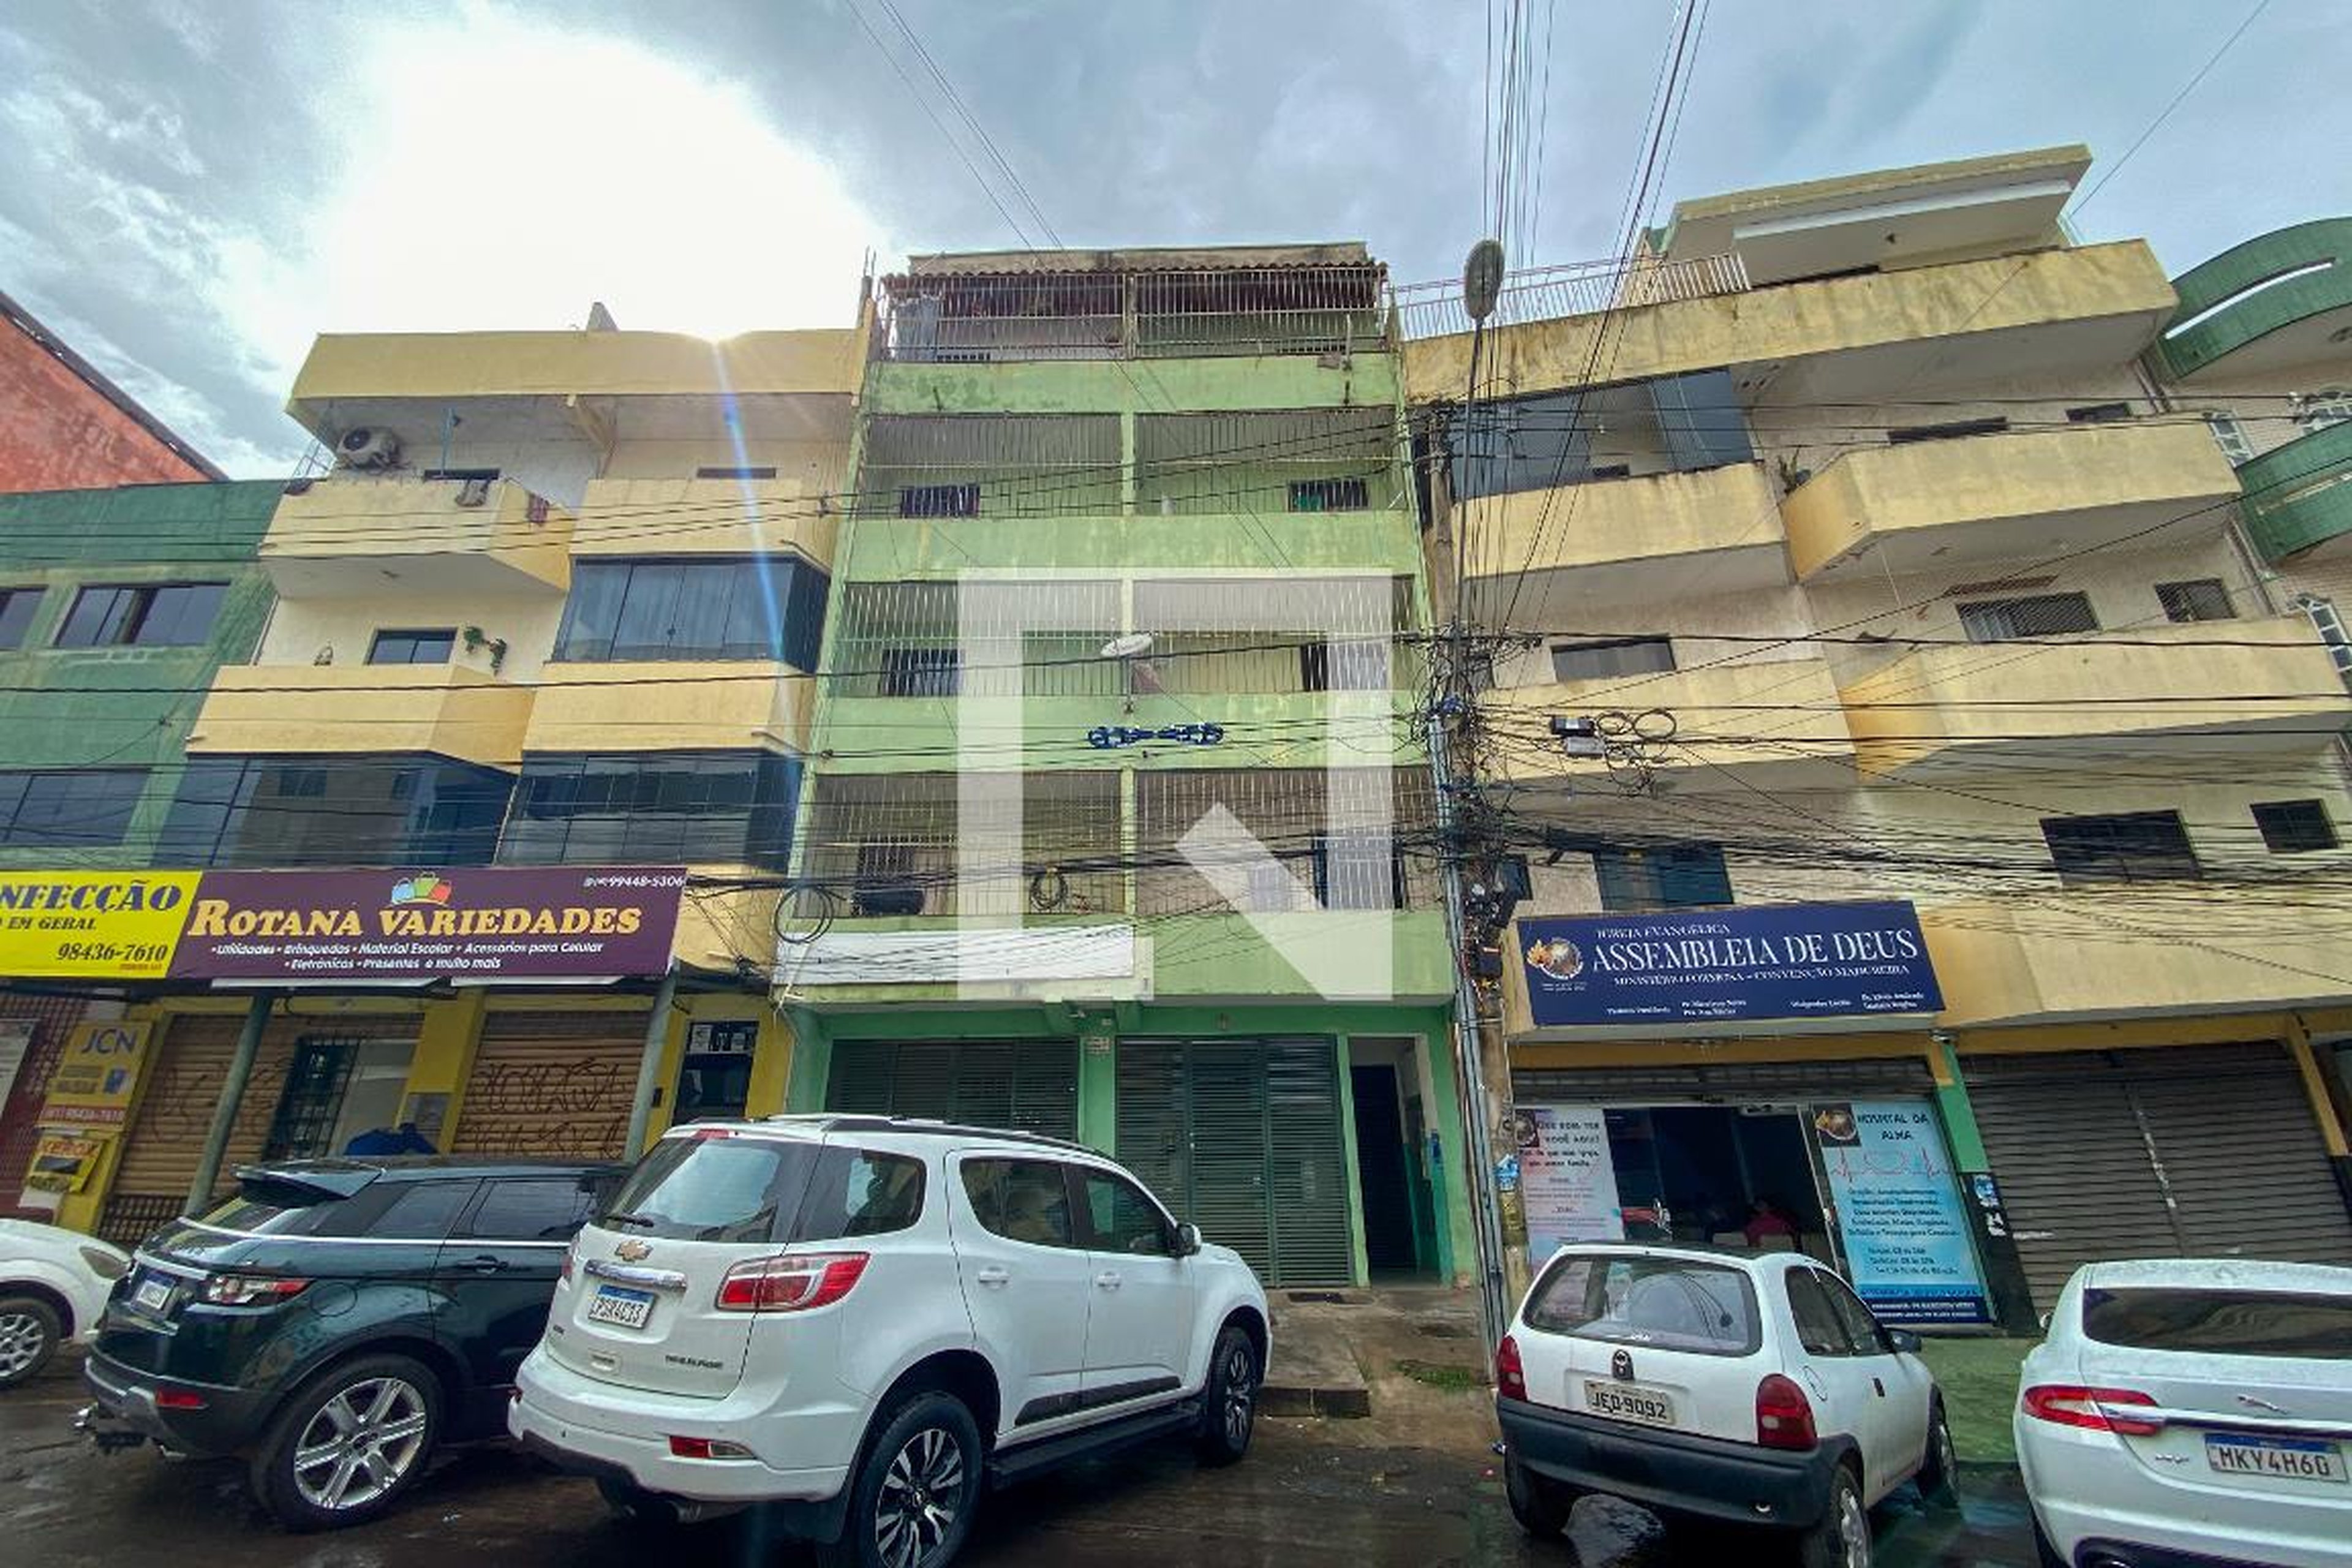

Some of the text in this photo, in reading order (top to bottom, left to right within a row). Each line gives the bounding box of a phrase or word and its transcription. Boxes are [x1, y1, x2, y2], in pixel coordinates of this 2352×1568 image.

[7, 916, 97, 930] EM GERAL
[187, 900, 642, 937] ROTANA VARIEDADES
[57, 943, 168, 961] 98436-7610
[359, 943, 409, 954] Material
[410, 943, 454, 954] Escolar
[528, 943, 558, 955] para
[1593, 928, 1918, 971] ASSEMBLEIA DE DEUS
[472, 957, 502, 968] mais
[80, 1028, 138, 1054] JCN
